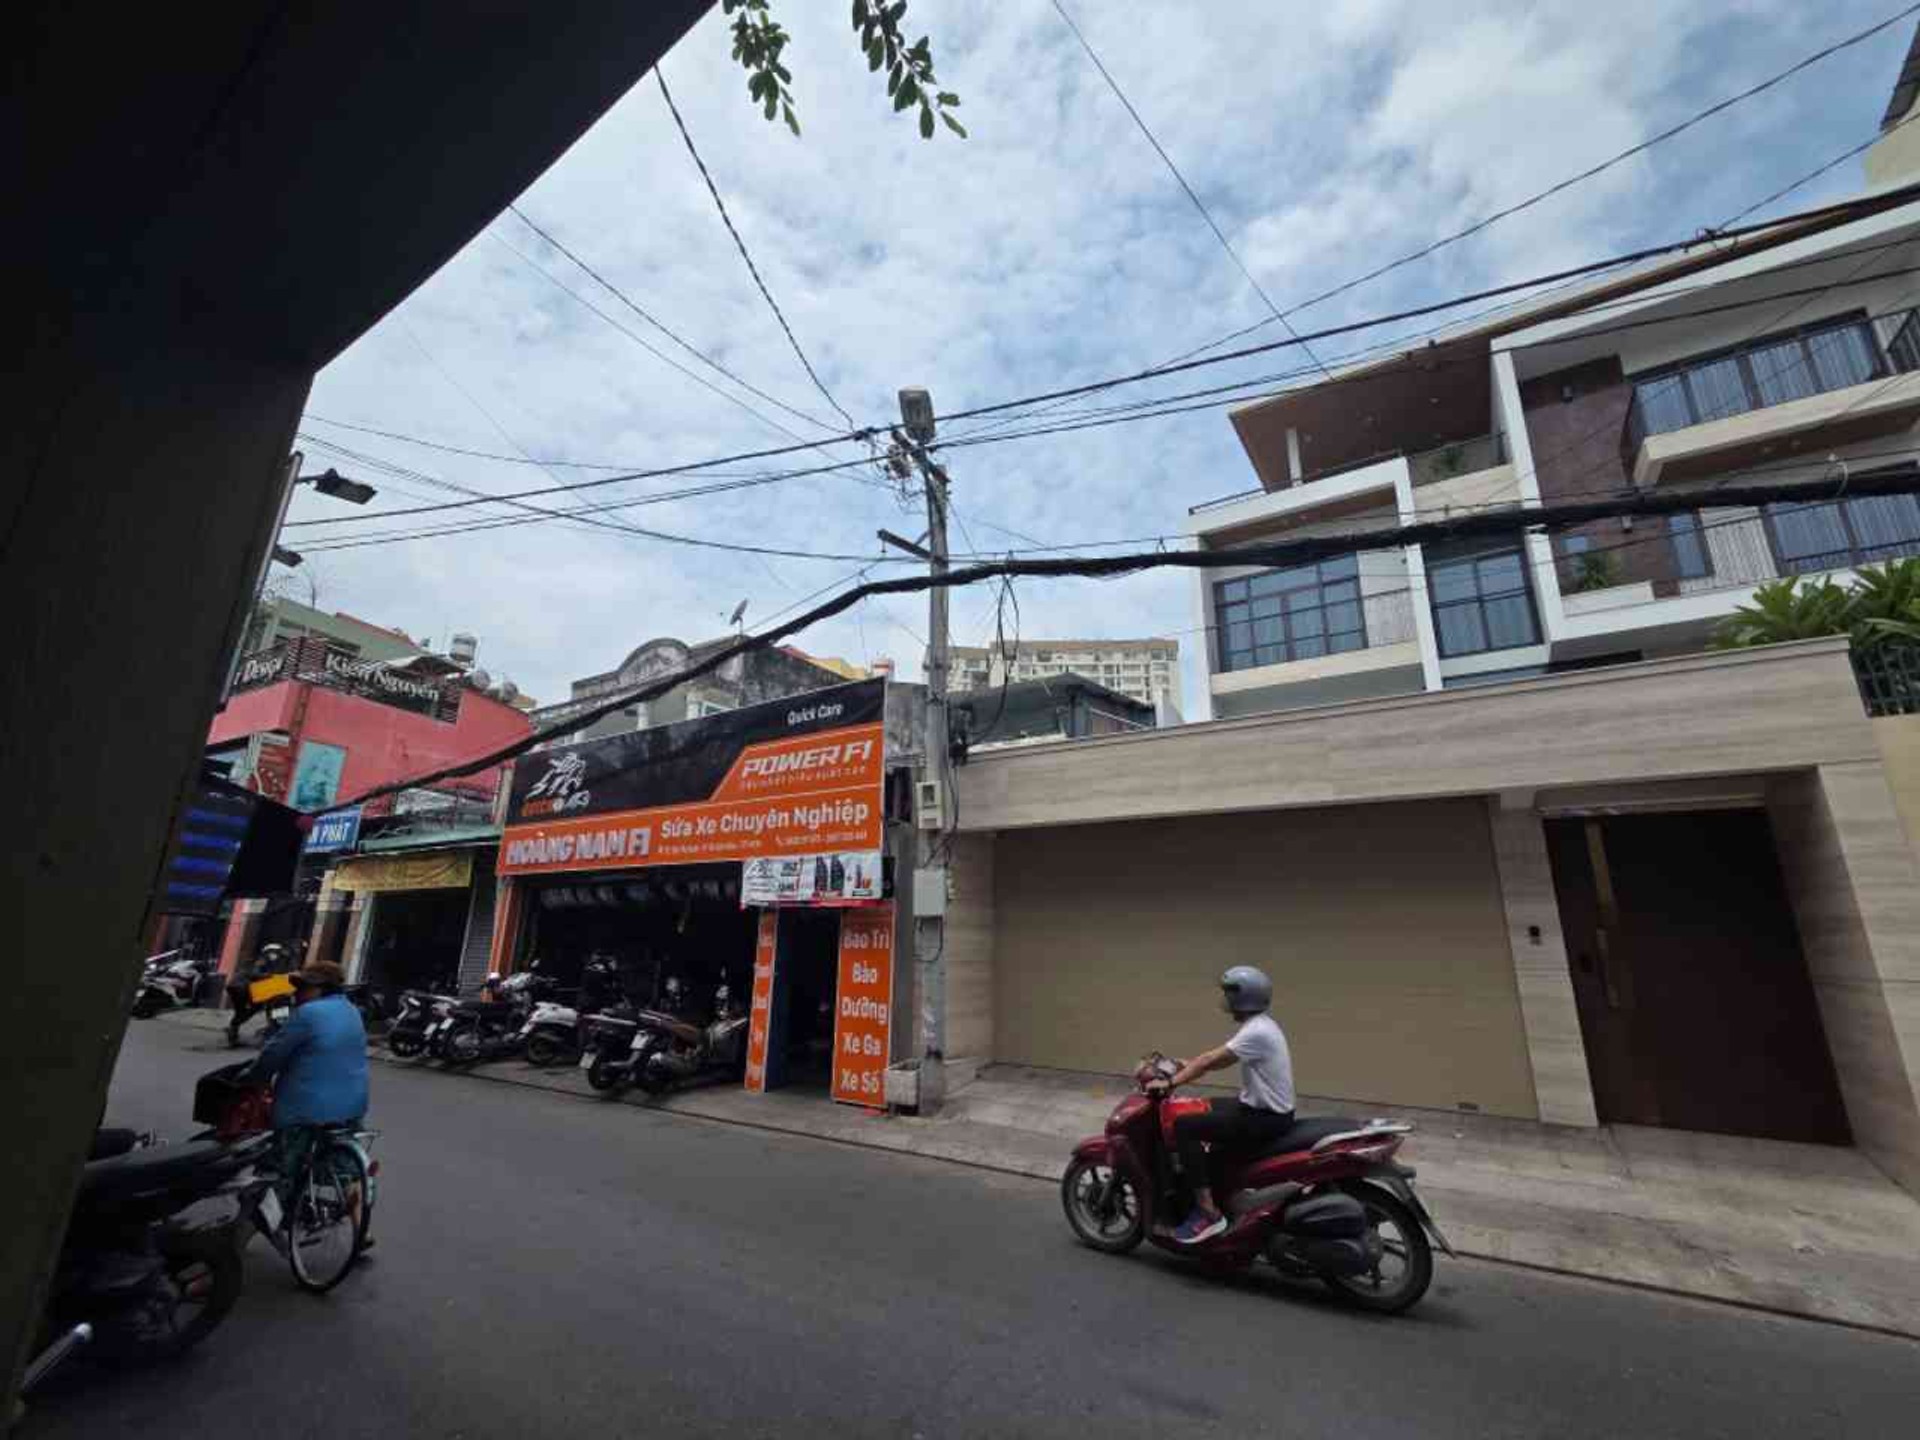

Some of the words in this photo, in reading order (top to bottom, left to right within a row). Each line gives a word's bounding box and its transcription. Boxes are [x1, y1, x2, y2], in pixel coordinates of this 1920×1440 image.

[741, 745, 842, 778] POWER
[696, 815, 717, 835] Xe
[720, 807, 789, 835] Chuyên
[793, 798, 869, 829] Nghiệp
[575, 828, 627, 860] NAM
[843, 1032, 860, 1054] Xe
[863, 1034, 881, 1056] Ga
[841, 1069, 858, 1091] Xe
